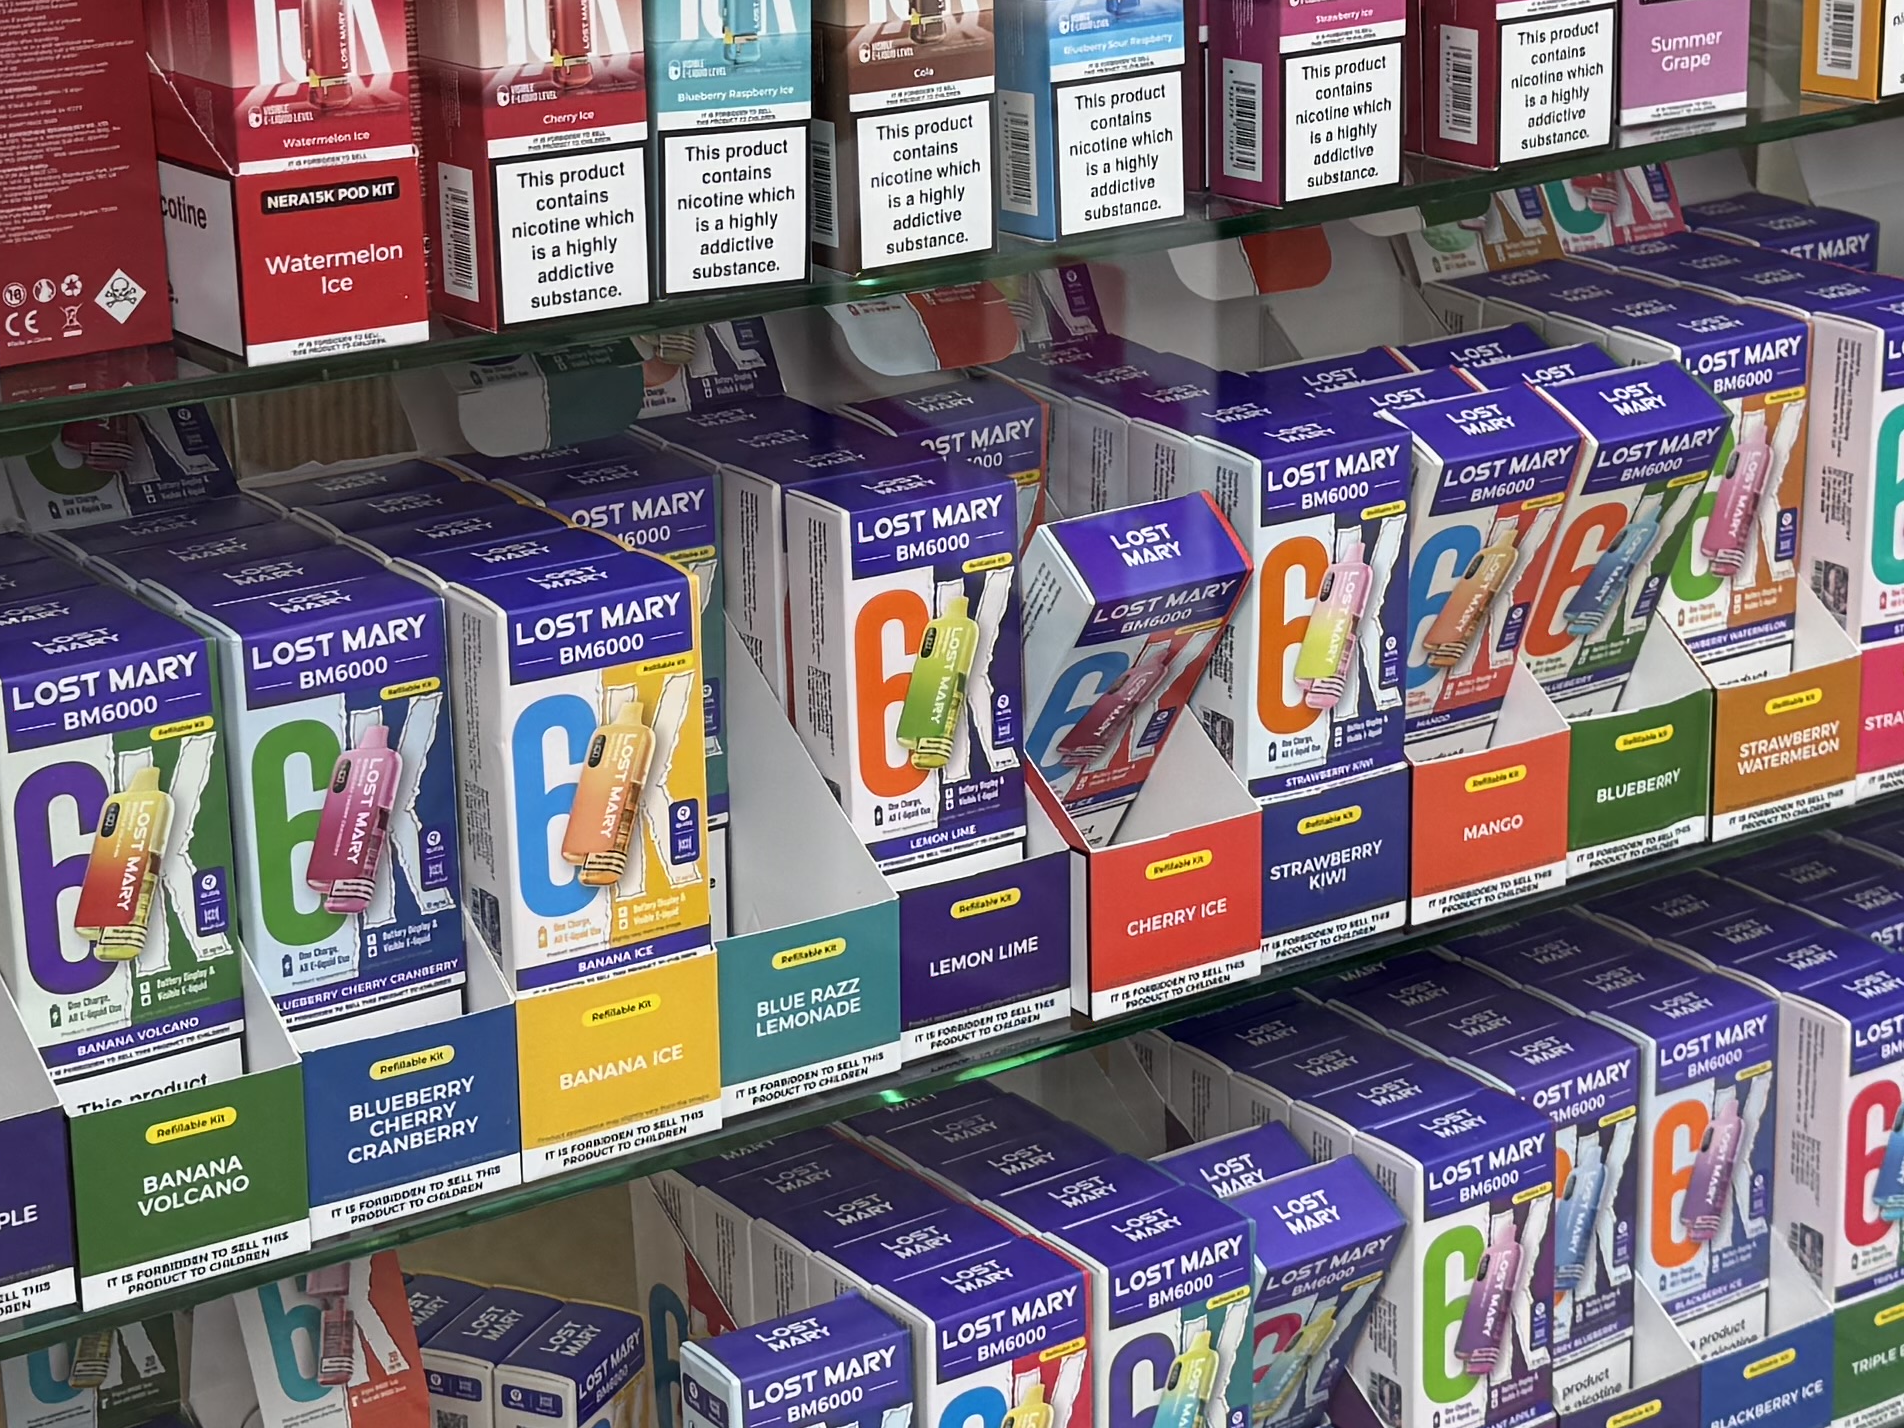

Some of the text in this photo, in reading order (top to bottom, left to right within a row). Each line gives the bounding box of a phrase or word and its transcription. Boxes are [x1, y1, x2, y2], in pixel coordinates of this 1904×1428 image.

[1652, 32, 1722, 52] Summer
[1662, 54, 1710, 71] Grape
[268, 183, 394, 208] NERA15K POD KIT
[265, 244, 402, 274] Watermelon
[322, 276, 352, 293] Ice
[1740, 721, 1839, 756] STRAWBERRY
[1738, 740, 1839, 775] WATERMELON
[1597, 768, 1680, 803] BLUEBERRY
[1464, 815, 1523, 841] MANGO
[758, 978, 860, 1017] BLUE RAZZ
[757, 996, 860, 1036] LEMONADE
[350, 1076, 474, 1122] BLUEBERRY
[370, 1102, 456, 1137] CHERRY
[348, 1116, 478, 1163] CRANBERRY
